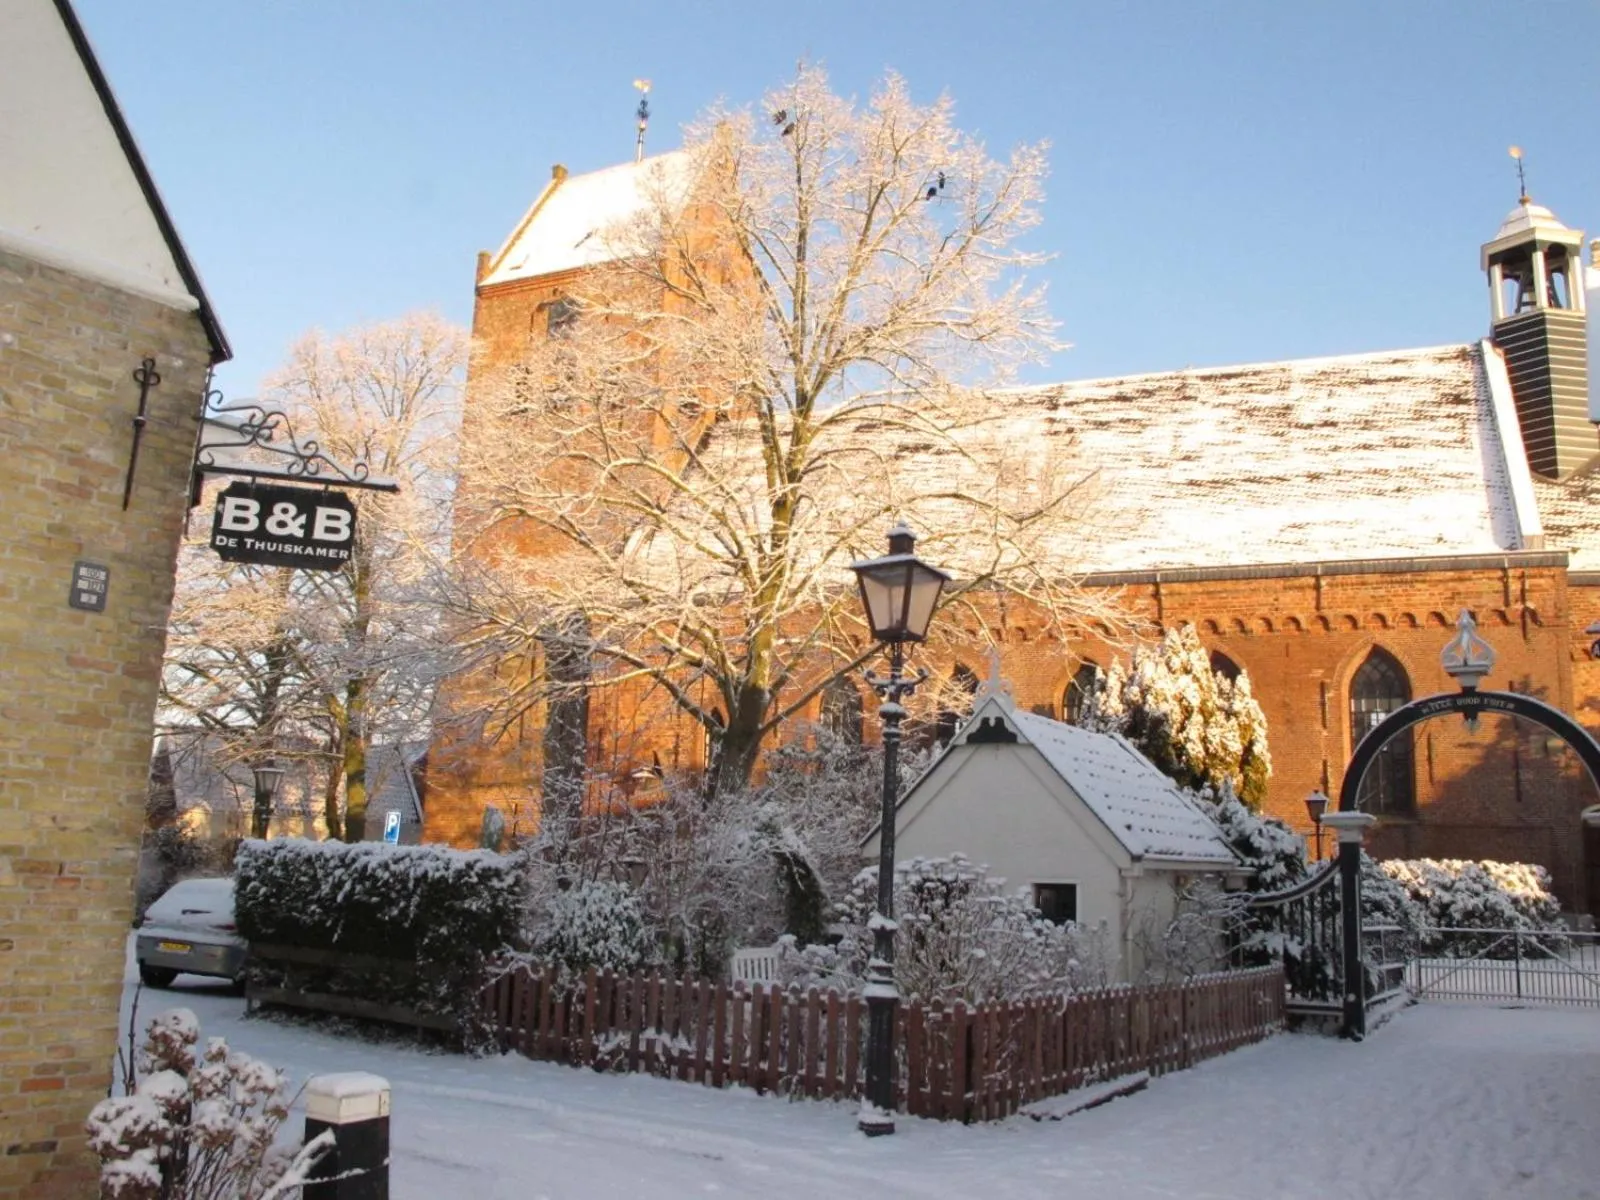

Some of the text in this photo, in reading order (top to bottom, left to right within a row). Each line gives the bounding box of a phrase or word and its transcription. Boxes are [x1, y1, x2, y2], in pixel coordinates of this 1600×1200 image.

[219, 496, 352, 542] B&B
[215, 535, 349, 560] DE THUISKAMER
[387, 814, 398, 833] P
